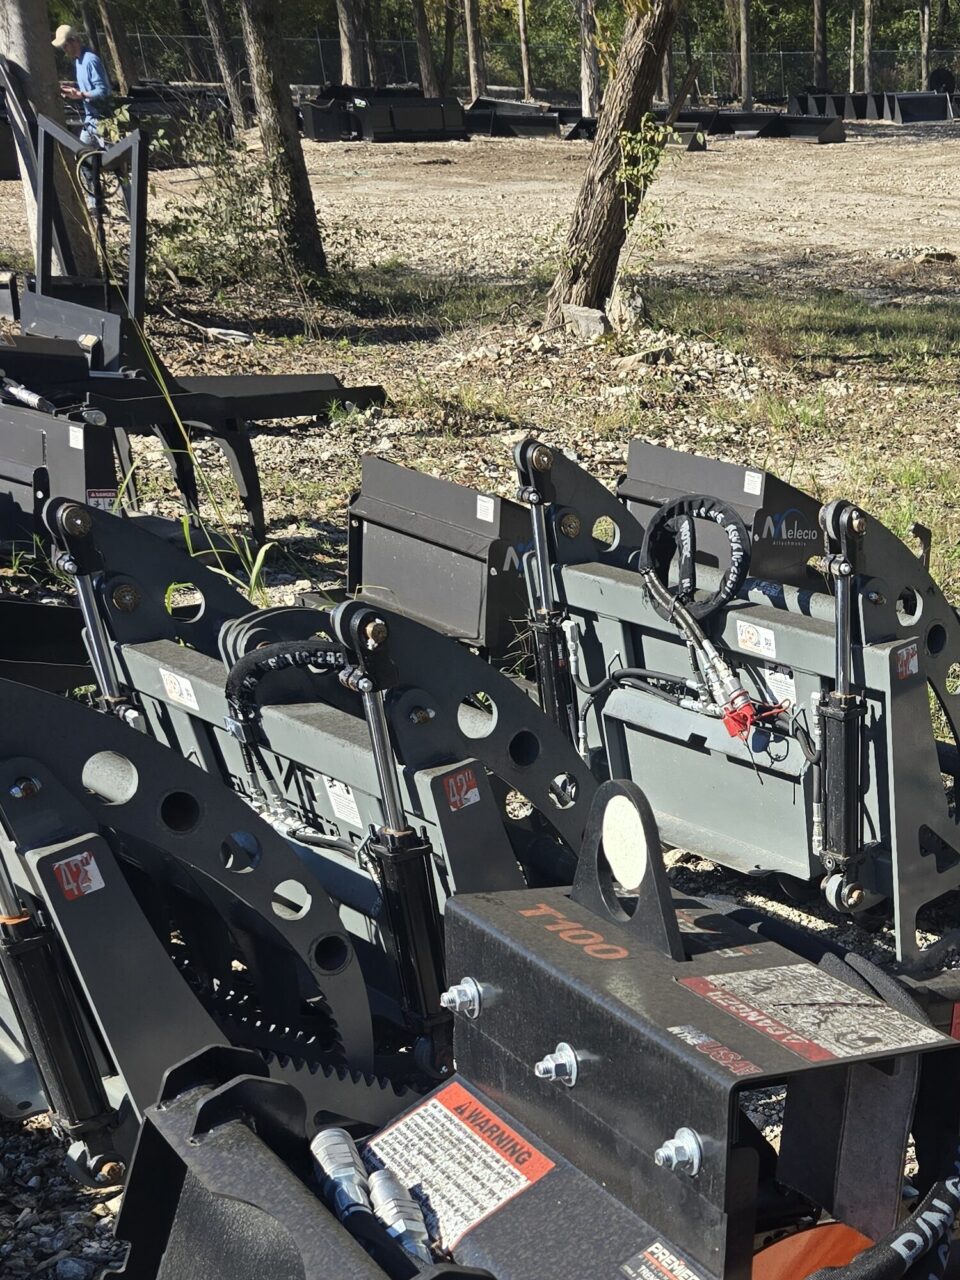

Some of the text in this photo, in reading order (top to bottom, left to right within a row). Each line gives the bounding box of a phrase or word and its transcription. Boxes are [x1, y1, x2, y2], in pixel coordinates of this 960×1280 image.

[762, 512, 818, 540] Melecio
[518, 903, 629, 960] T100
[707, 991, 791, 1035] DANGER
[696, 1040, 761, 1075] USA
[464, 1107, 533, 1166] WARNING
